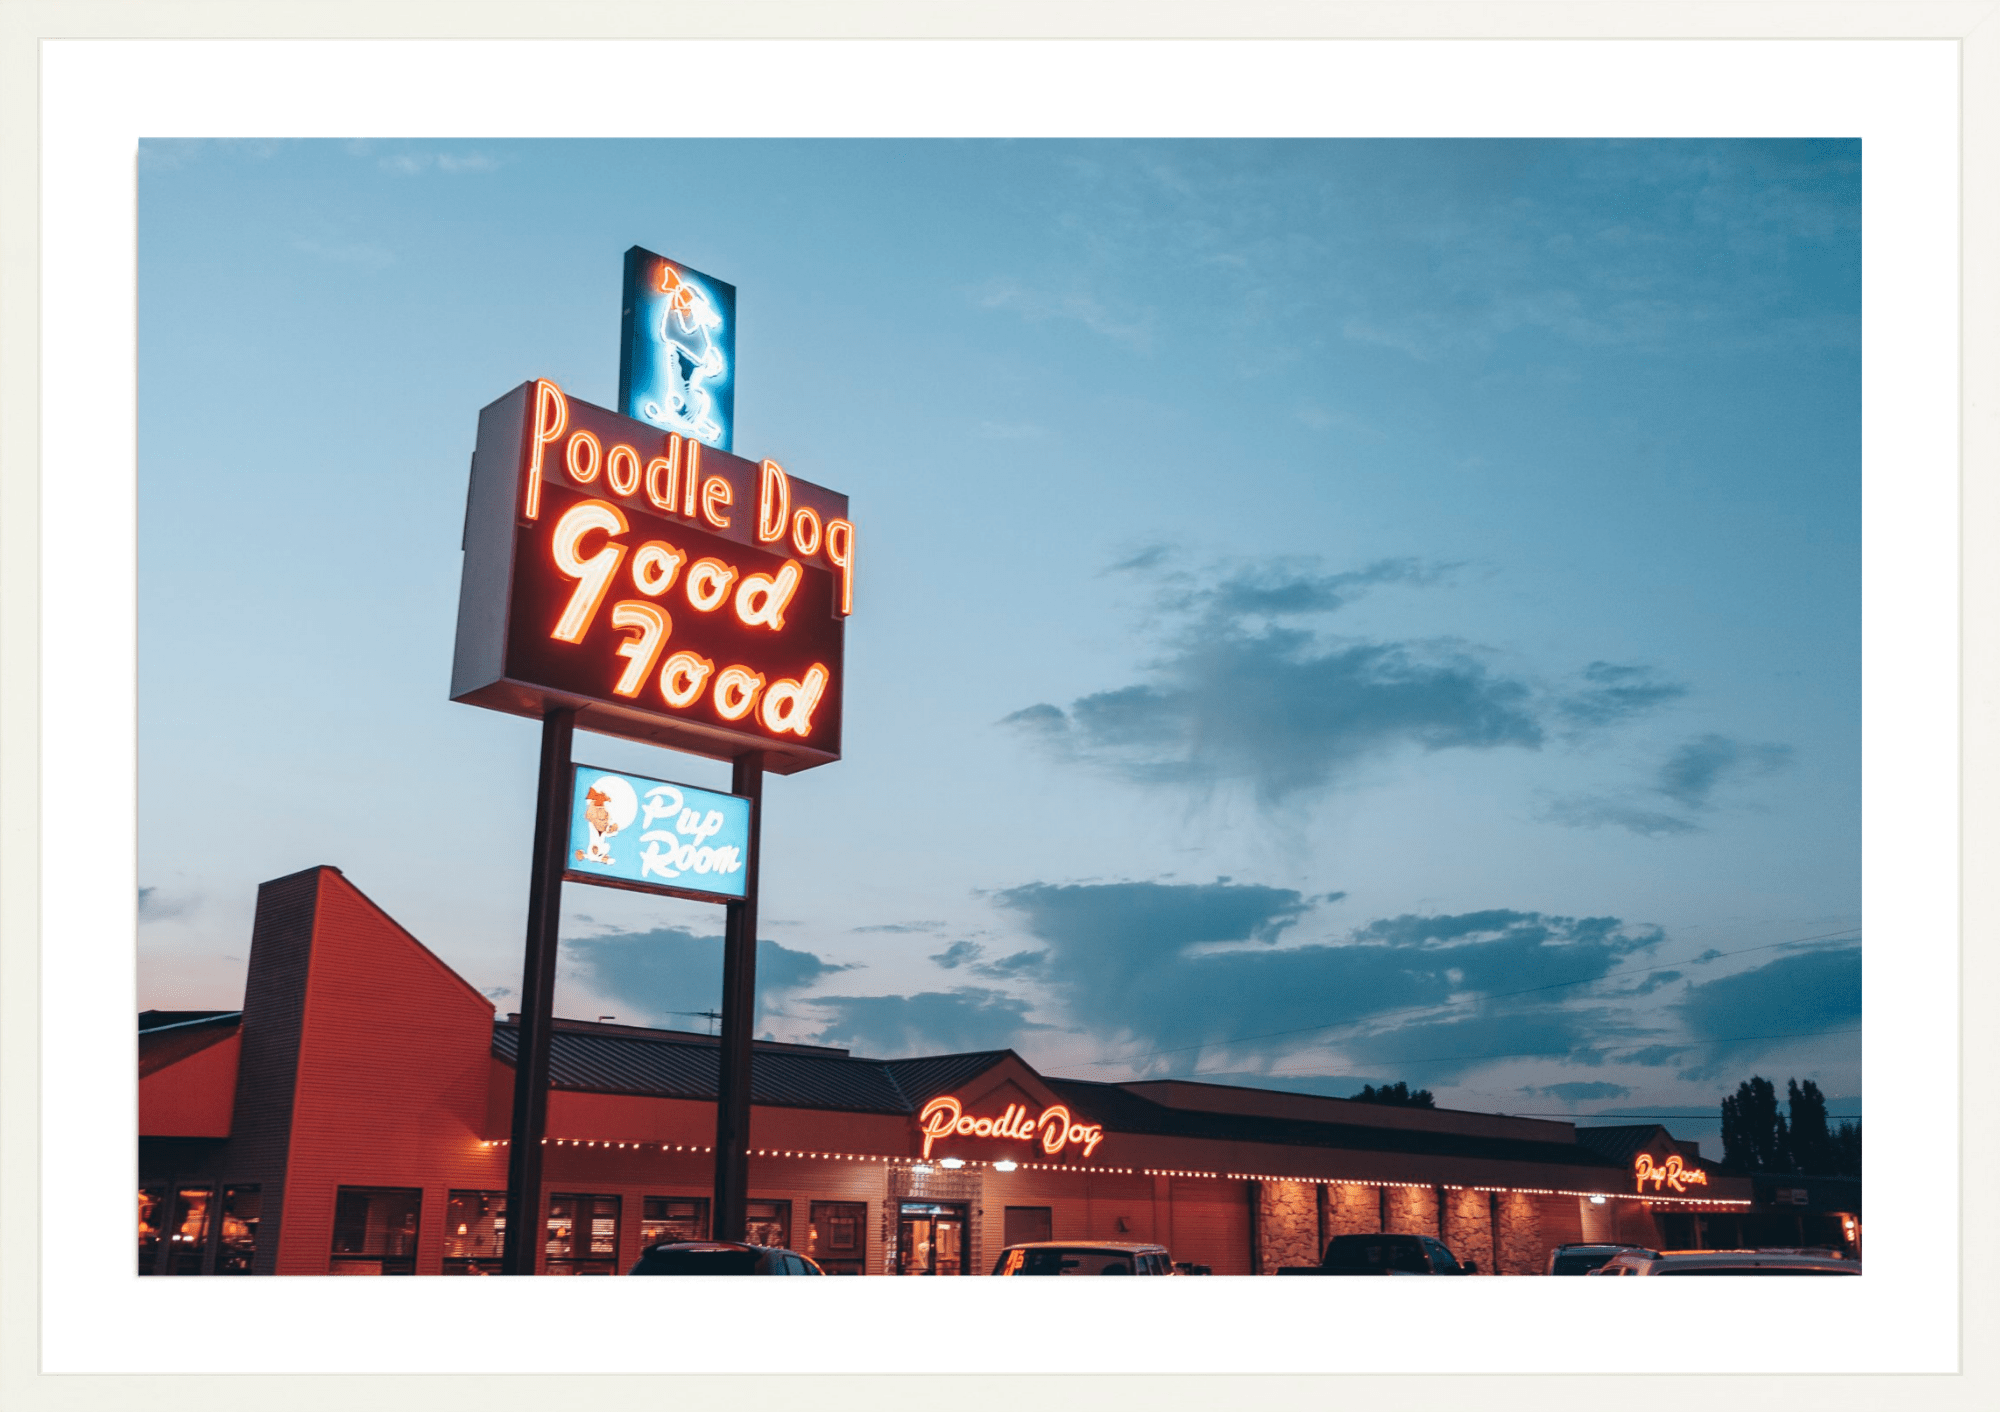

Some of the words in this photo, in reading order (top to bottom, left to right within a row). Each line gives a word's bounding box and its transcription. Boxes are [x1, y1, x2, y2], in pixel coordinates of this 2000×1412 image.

[525, 376, 734, 529] Poodle
[549, 498, 804, 645] Good
[611, 598, 830, 738] Food
[641, 785, 725, 847] Pup
[638, 829, 743, 879] Room
[919, 1095, 1037, 1159] Poodle
[1037, 1104, 1103, 1158] Dog
[1635, 1153, 1667, 1194] Pup
[1665, 1155, 1708, 1193] Room
